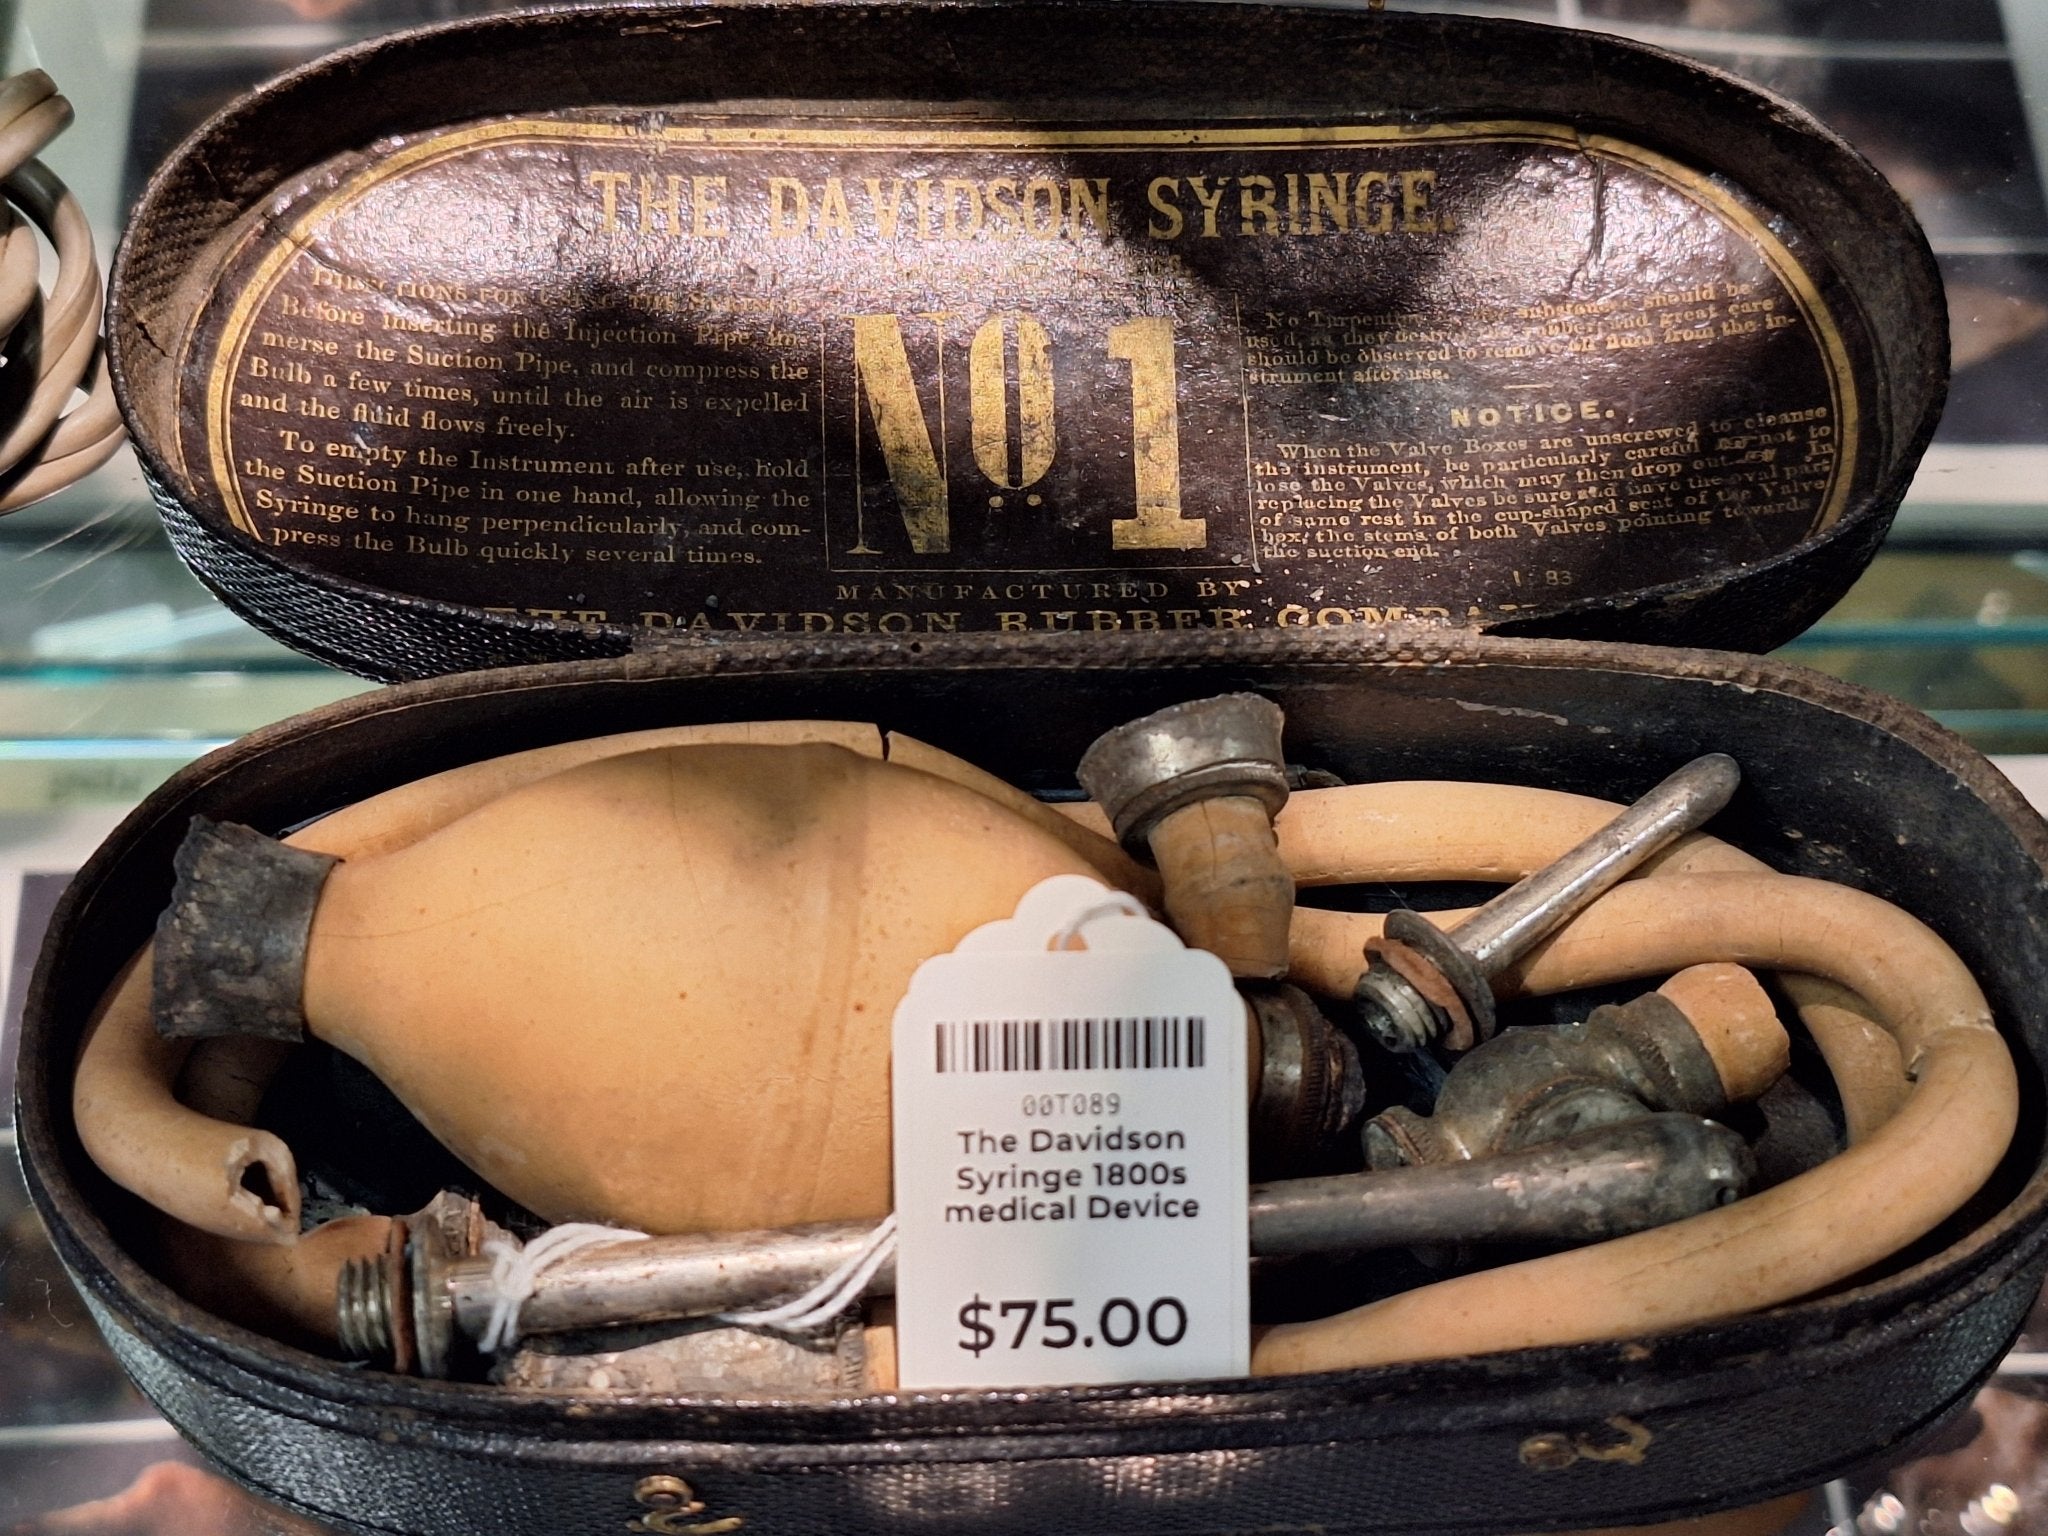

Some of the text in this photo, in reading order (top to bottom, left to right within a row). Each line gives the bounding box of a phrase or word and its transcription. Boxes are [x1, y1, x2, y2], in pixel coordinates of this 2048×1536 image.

[589, 170, 1457, 244] THE DAVIDSON SYRINGE.
[281, 295, 365, 326] Before
[383, 312, 500, 344] inserting
[512, 317, 550, 340] the
[565, 318, 678, 348] Injection
[1265, 282, 1750, 329] No should be
[1660, 304, 1718, 328] great
[1728, 298, 1775, 315] care
[263, 331, 338, 356] merse
[355, 340, 395, 362] the
[407, 344, 503, 370] Suction
[591, 358, 634, 378] and
[647, 360, 760, 385] compress
[770, 360, 809, 380] the
[1248, 349, 1318, 367] should
[1327, 350, 1350, 365] be
[1358, 345, 1450, 365] observed
[1458, 347, 1478, 360] to
[1664, 326, 1716, 344] from
[1721, 319, 1758, 337] the
[251, 356, 810, 417] Bulb a few times, until the air is expelled
[1249, 366, 1450, 385] strument after use.
[240, 391, 575, 445] and the fluid flows freely.
[1108, 315, 1207, 551] 1
[1277, 442, 1341, 459] When
[1347, 443, 1380, 458] the
[1388, 441, 1453, 457] Valve
[1463, 438, 1528, 455] Boxes
[1540, 437, 1573, 451] are
[1584, 421, 1699, 447] unscrewed
[1709, 420, 1732, 433] to
[1744, 406, 1828, 429] cleanse
[1451, 400, 1616, 428] NOTICE.
[280, 430, 809, 481] To empty the Instrument after use, hold
[1254, 460, 1291, 477] the
[1303, 460, 1431, 477] instrument,
[1445, 458, 1470, 473] be
[1482, 447, 1612, 475] particularly
[1624, 438, 1700, 461] careful
[1760, 428, 1799, 445] not
[1808, 424, 1832, 439] to
[245, 458, 811, 511] the Suction Pipe in one hand, allowing the
[1255, 478, 1301, 493] lose
[1311, 475, 1346, 491] the
[1441, 474, 1505, 491] which
[1517, 470, 1566, 489] may
[1576, 467, 1625, 484] then
[1631, 462, 1683, 480] drop
[1257, 494, 1363, 512] replacing
[1368, 495, 1402, 510] the
[1408, 493, 1487, 509] Valves
[1493, 488, 1518, 505] be
[1524, 489, 1572, 504] sure
[256, 489, 811, 541] Syringe to hang perpendicularly, and com-
[1260, 513, 1282, 527] of
[1294, 512, 1350, 528] same
[1361, 512, 1404, 527] rest
[1413, 511, 1437, 527] in
[1447, 508, 1482, 525] the
[1494, 497, 1620, 523] cup-shaped
[1629, 495, 1674, 512] seat
[1684, 490, 1709, 507] of
[1758, 479, 1826, 498] Valve
[1316, 528, 1355, 543] the
[1364, 528, 1425, 543] stems
[1436, 525, 1459, 541] of
[1469, 522, 1518, 540] both
[1529, 518, 1607, 538] Valves
[1616, 508, 1713, 533] pointing
[271, 526, 763, 565] press the Bulb quickly several times.
[1262, 544, 1298, 559] the
[1307, 544, 1387, 560] suction
[837, 580, 1243, 600] MANUFACTURED BY
[640, 611, 962, 634] DAVIDSON
[995, 606, 1249, 632] RUBBER
[1023, 1093, 1121, 1117] 00T089
[957, 1126, 1186, 1155] The Davidson
[957, 1161, 1188, 1195] Syringe 1800s
[945, 1192, 1201, 1223] medical Device
[957, 1293, 1189, 1359] $75.00
